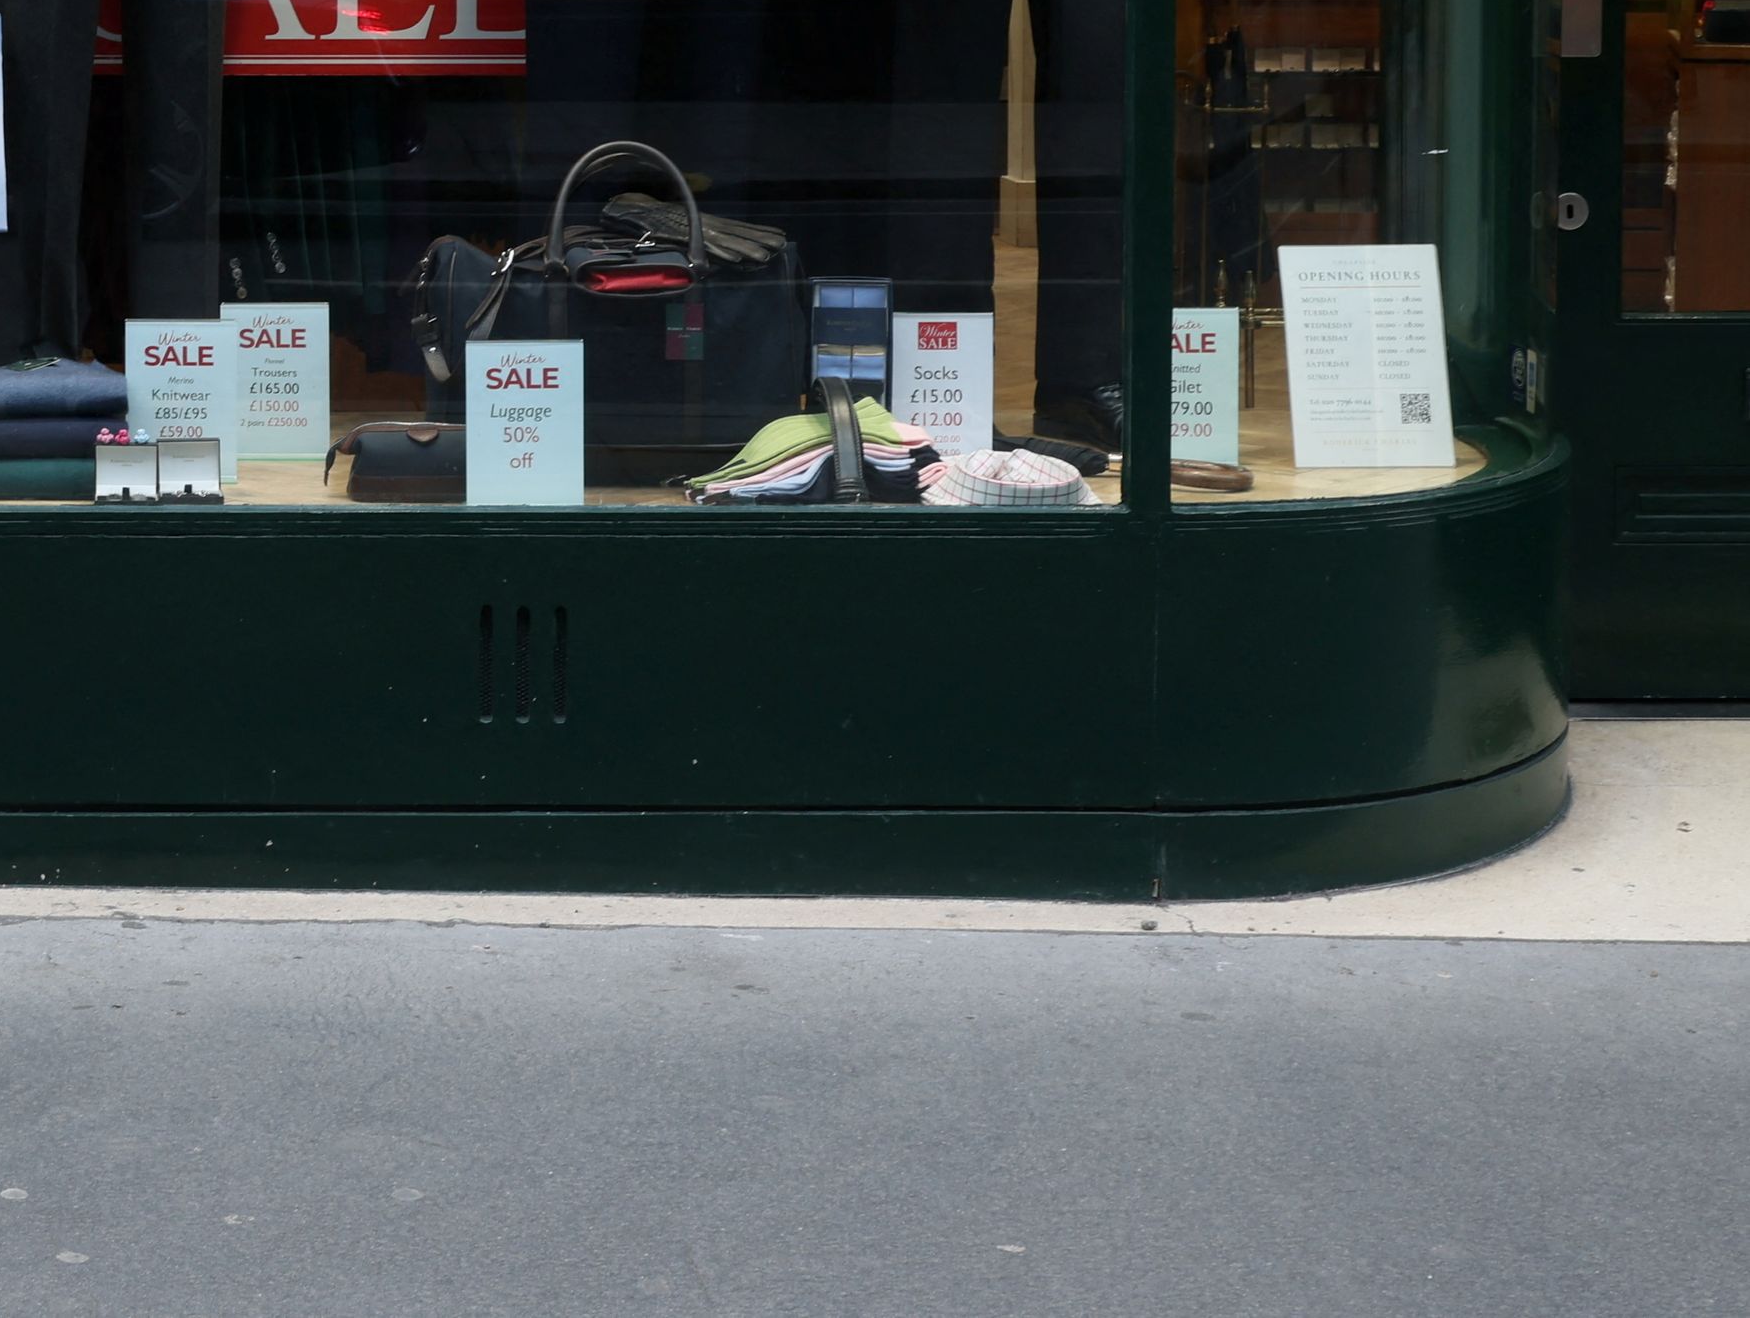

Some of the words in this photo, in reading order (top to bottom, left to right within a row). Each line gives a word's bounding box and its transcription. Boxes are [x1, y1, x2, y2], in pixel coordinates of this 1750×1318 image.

[1298, 271, 1364, 281] OPENING
[1370, 271, 1421, 280] HOURS
[252, 314, 294, 328] Winter
[919, 323, 956, 337] Winter
[158, 331, 201, 346] Winter
[239, 329, 306, 349] SALE
[919, 338, 957, 349] SALE
[1170, 333, 1216, 353] ALE
[144, 346, 214, 366] SALE
[501, 352, 546, 367] Winter
[252, 367, 297, 378] Trousers
[914, 366, 958, 380] Socks
[1171, 364, 1201, 373] nitted
[486, 368, 559, 389] SALE
[250, 383, 299, 394] £165.00
[1171, 380, 1202, 393] Gilet
[152, 389, 211, 401] Knitwear
[910, 389, 963, 403] £15.00
[155, 407, 207, 419] £85/£95
[250, 400, 299, 412] £150.00
[491, 404, 552, 422] Luggage
[1172, 401, 1213, 415] 79.00
[267, 418, 307, 426] £250.00
[911, 412, 963, 426] £12.00
[160, 426, 203, 438] £59.00
[503, 427, 539, 443] 50%
[1171, 423, 1212, 437] 29.00
[510, 452, 534, 468] off
